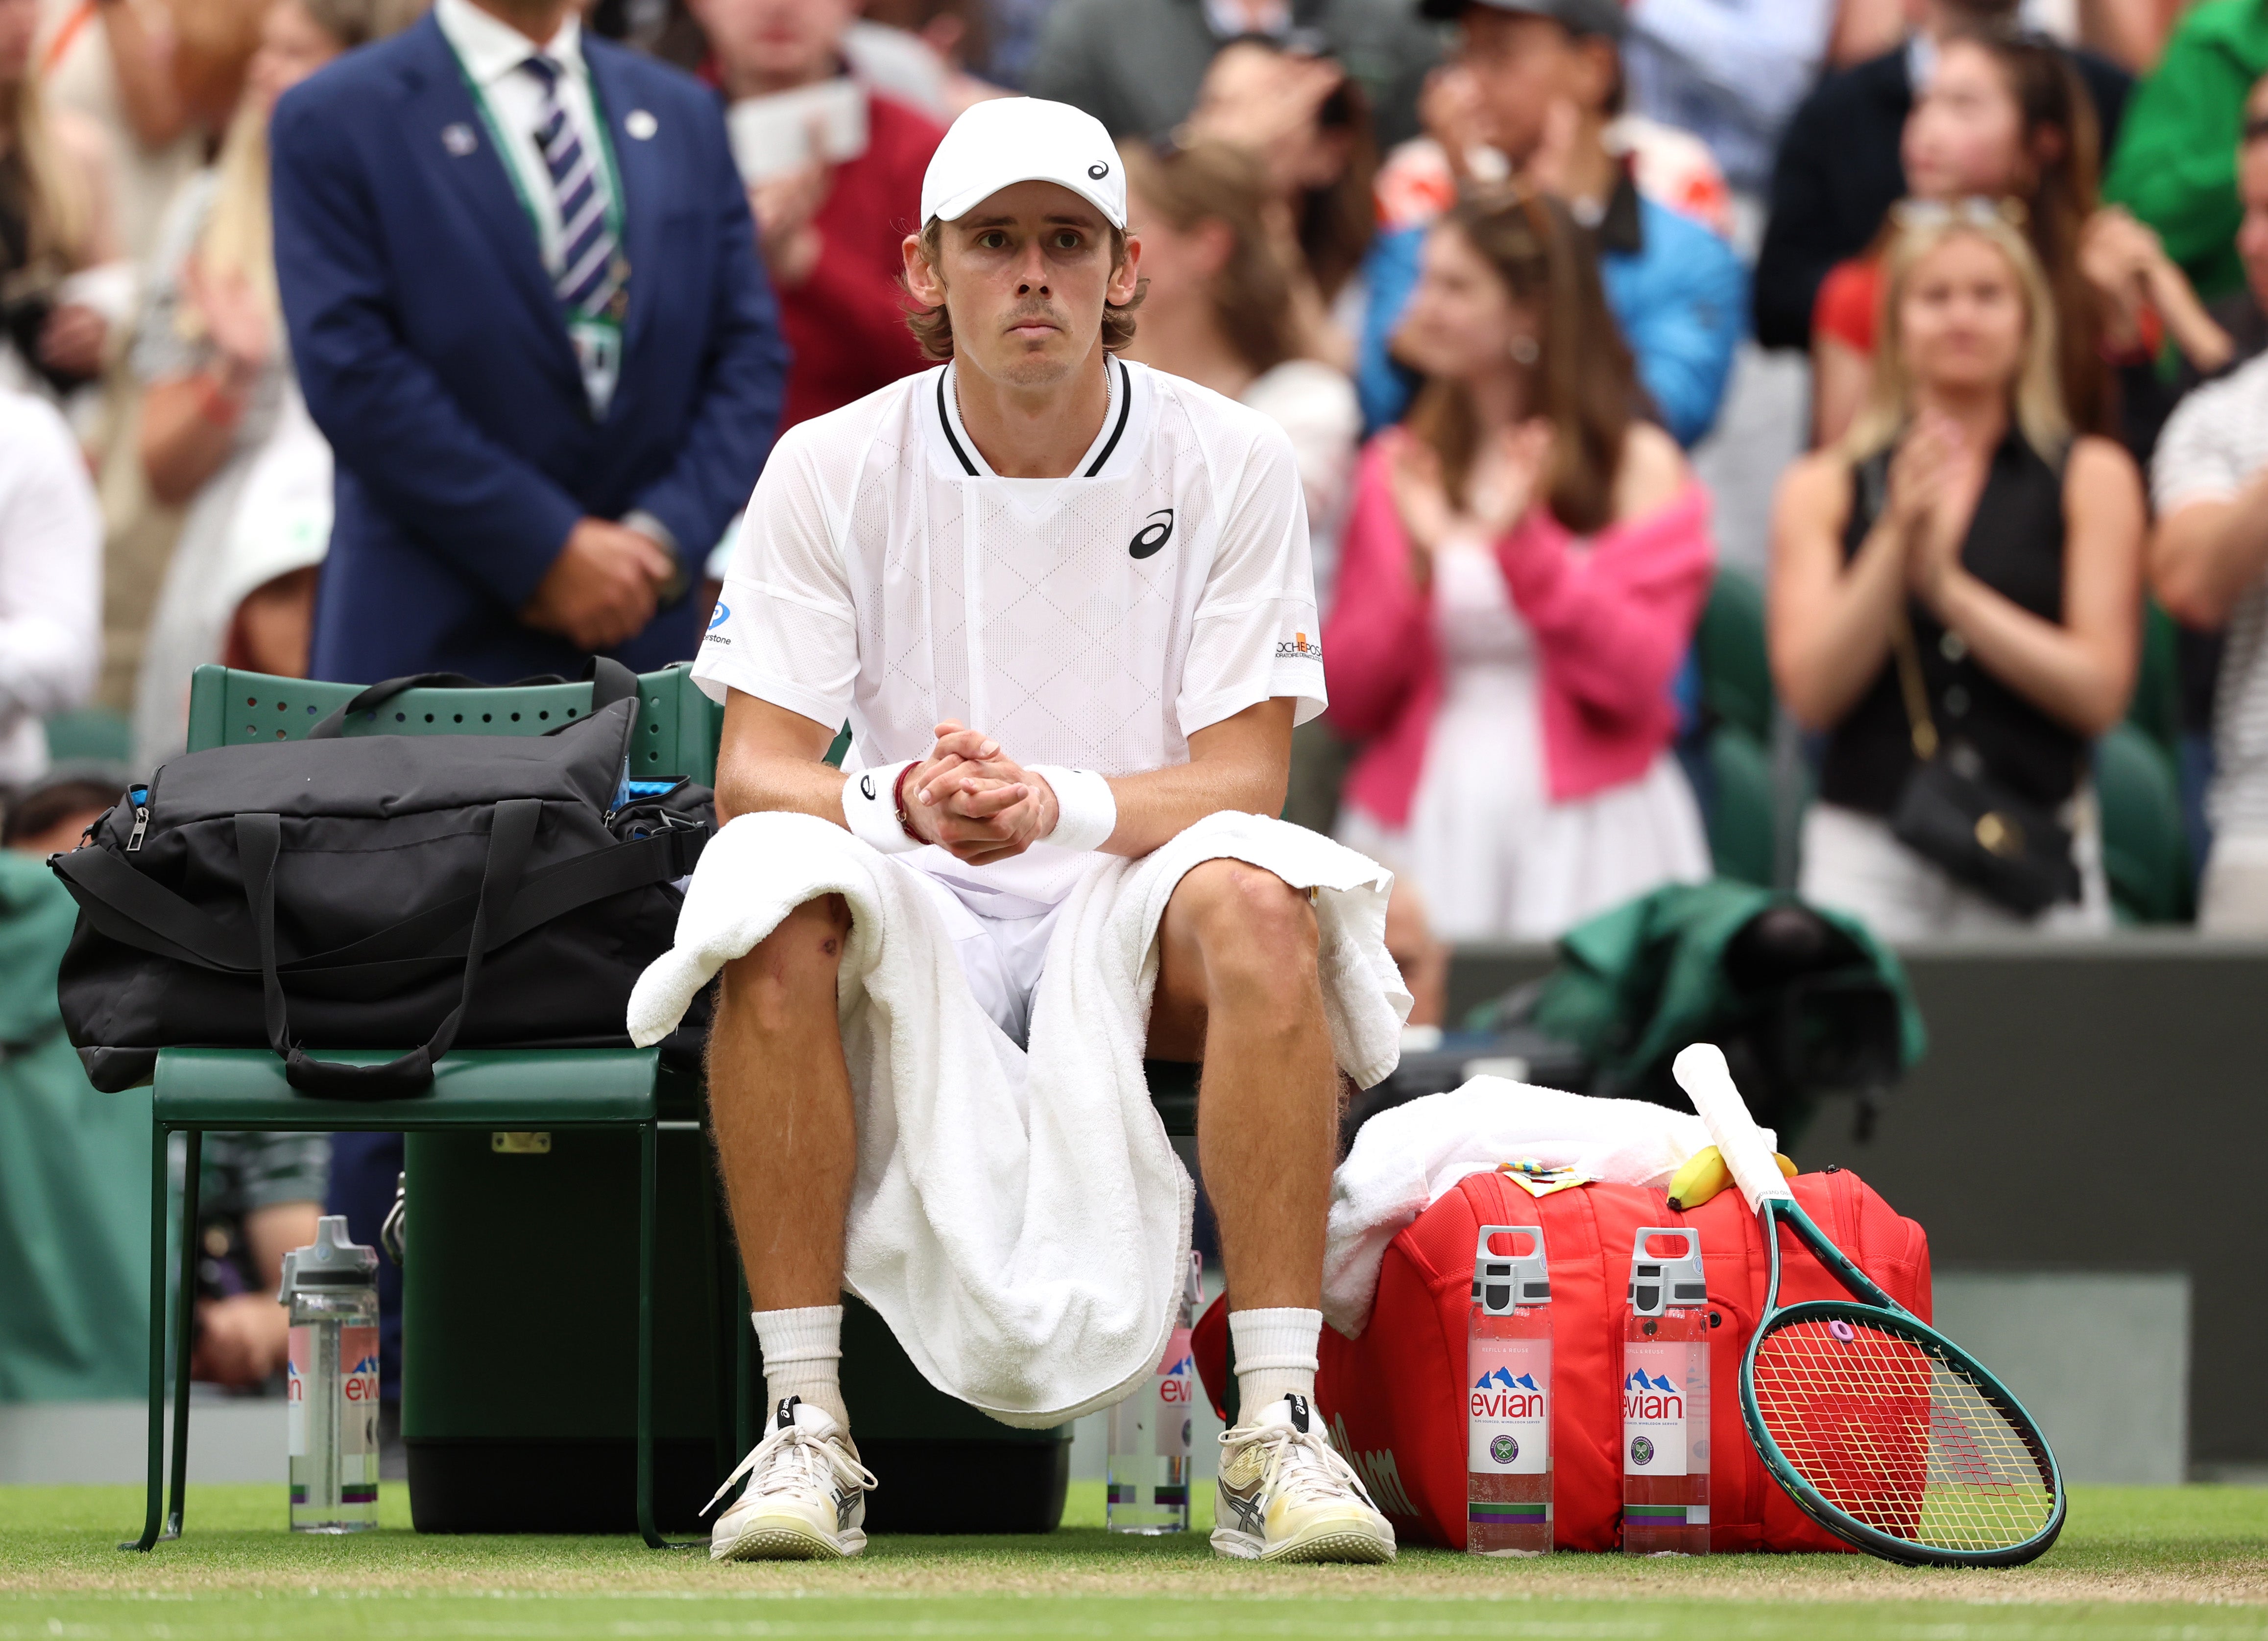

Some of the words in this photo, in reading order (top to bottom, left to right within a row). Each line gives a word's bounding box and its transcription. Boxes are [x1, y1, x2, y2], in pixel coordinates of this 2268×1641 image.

[1755, 1190, 1779, 1204] OVERGRIP
[1471, 1389, 1543, 1418] evian
[1495, 1436, 1518, 1449] CHAMPIONSHIPS
